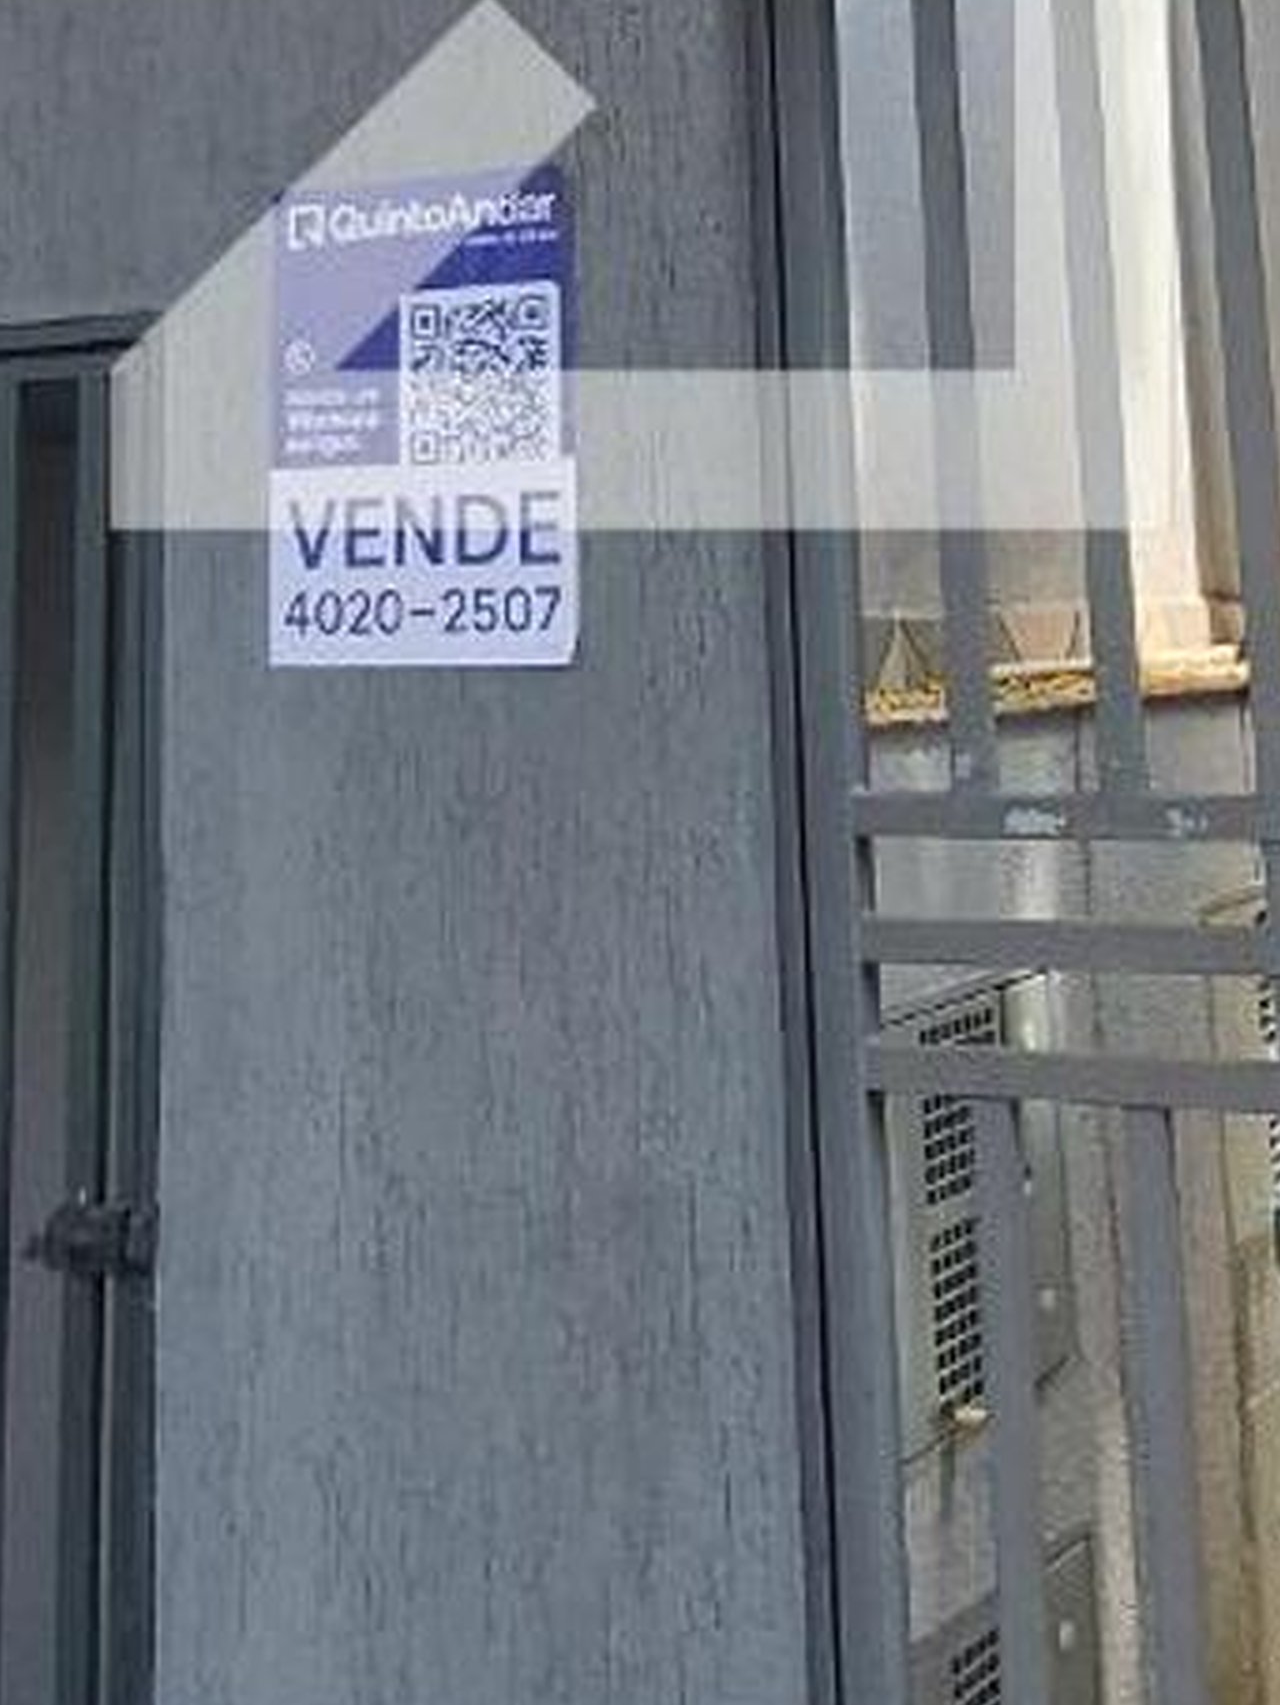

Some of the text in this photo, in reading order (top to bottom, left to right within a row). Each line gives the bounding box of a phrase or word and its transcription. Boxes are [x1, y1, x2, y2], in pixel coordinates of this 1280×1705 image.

[329, 192, 557, 241] QuintoAndar
[290, 492, 562, 570] VENDE
[285, 587, 561, 636] 4020-2507
